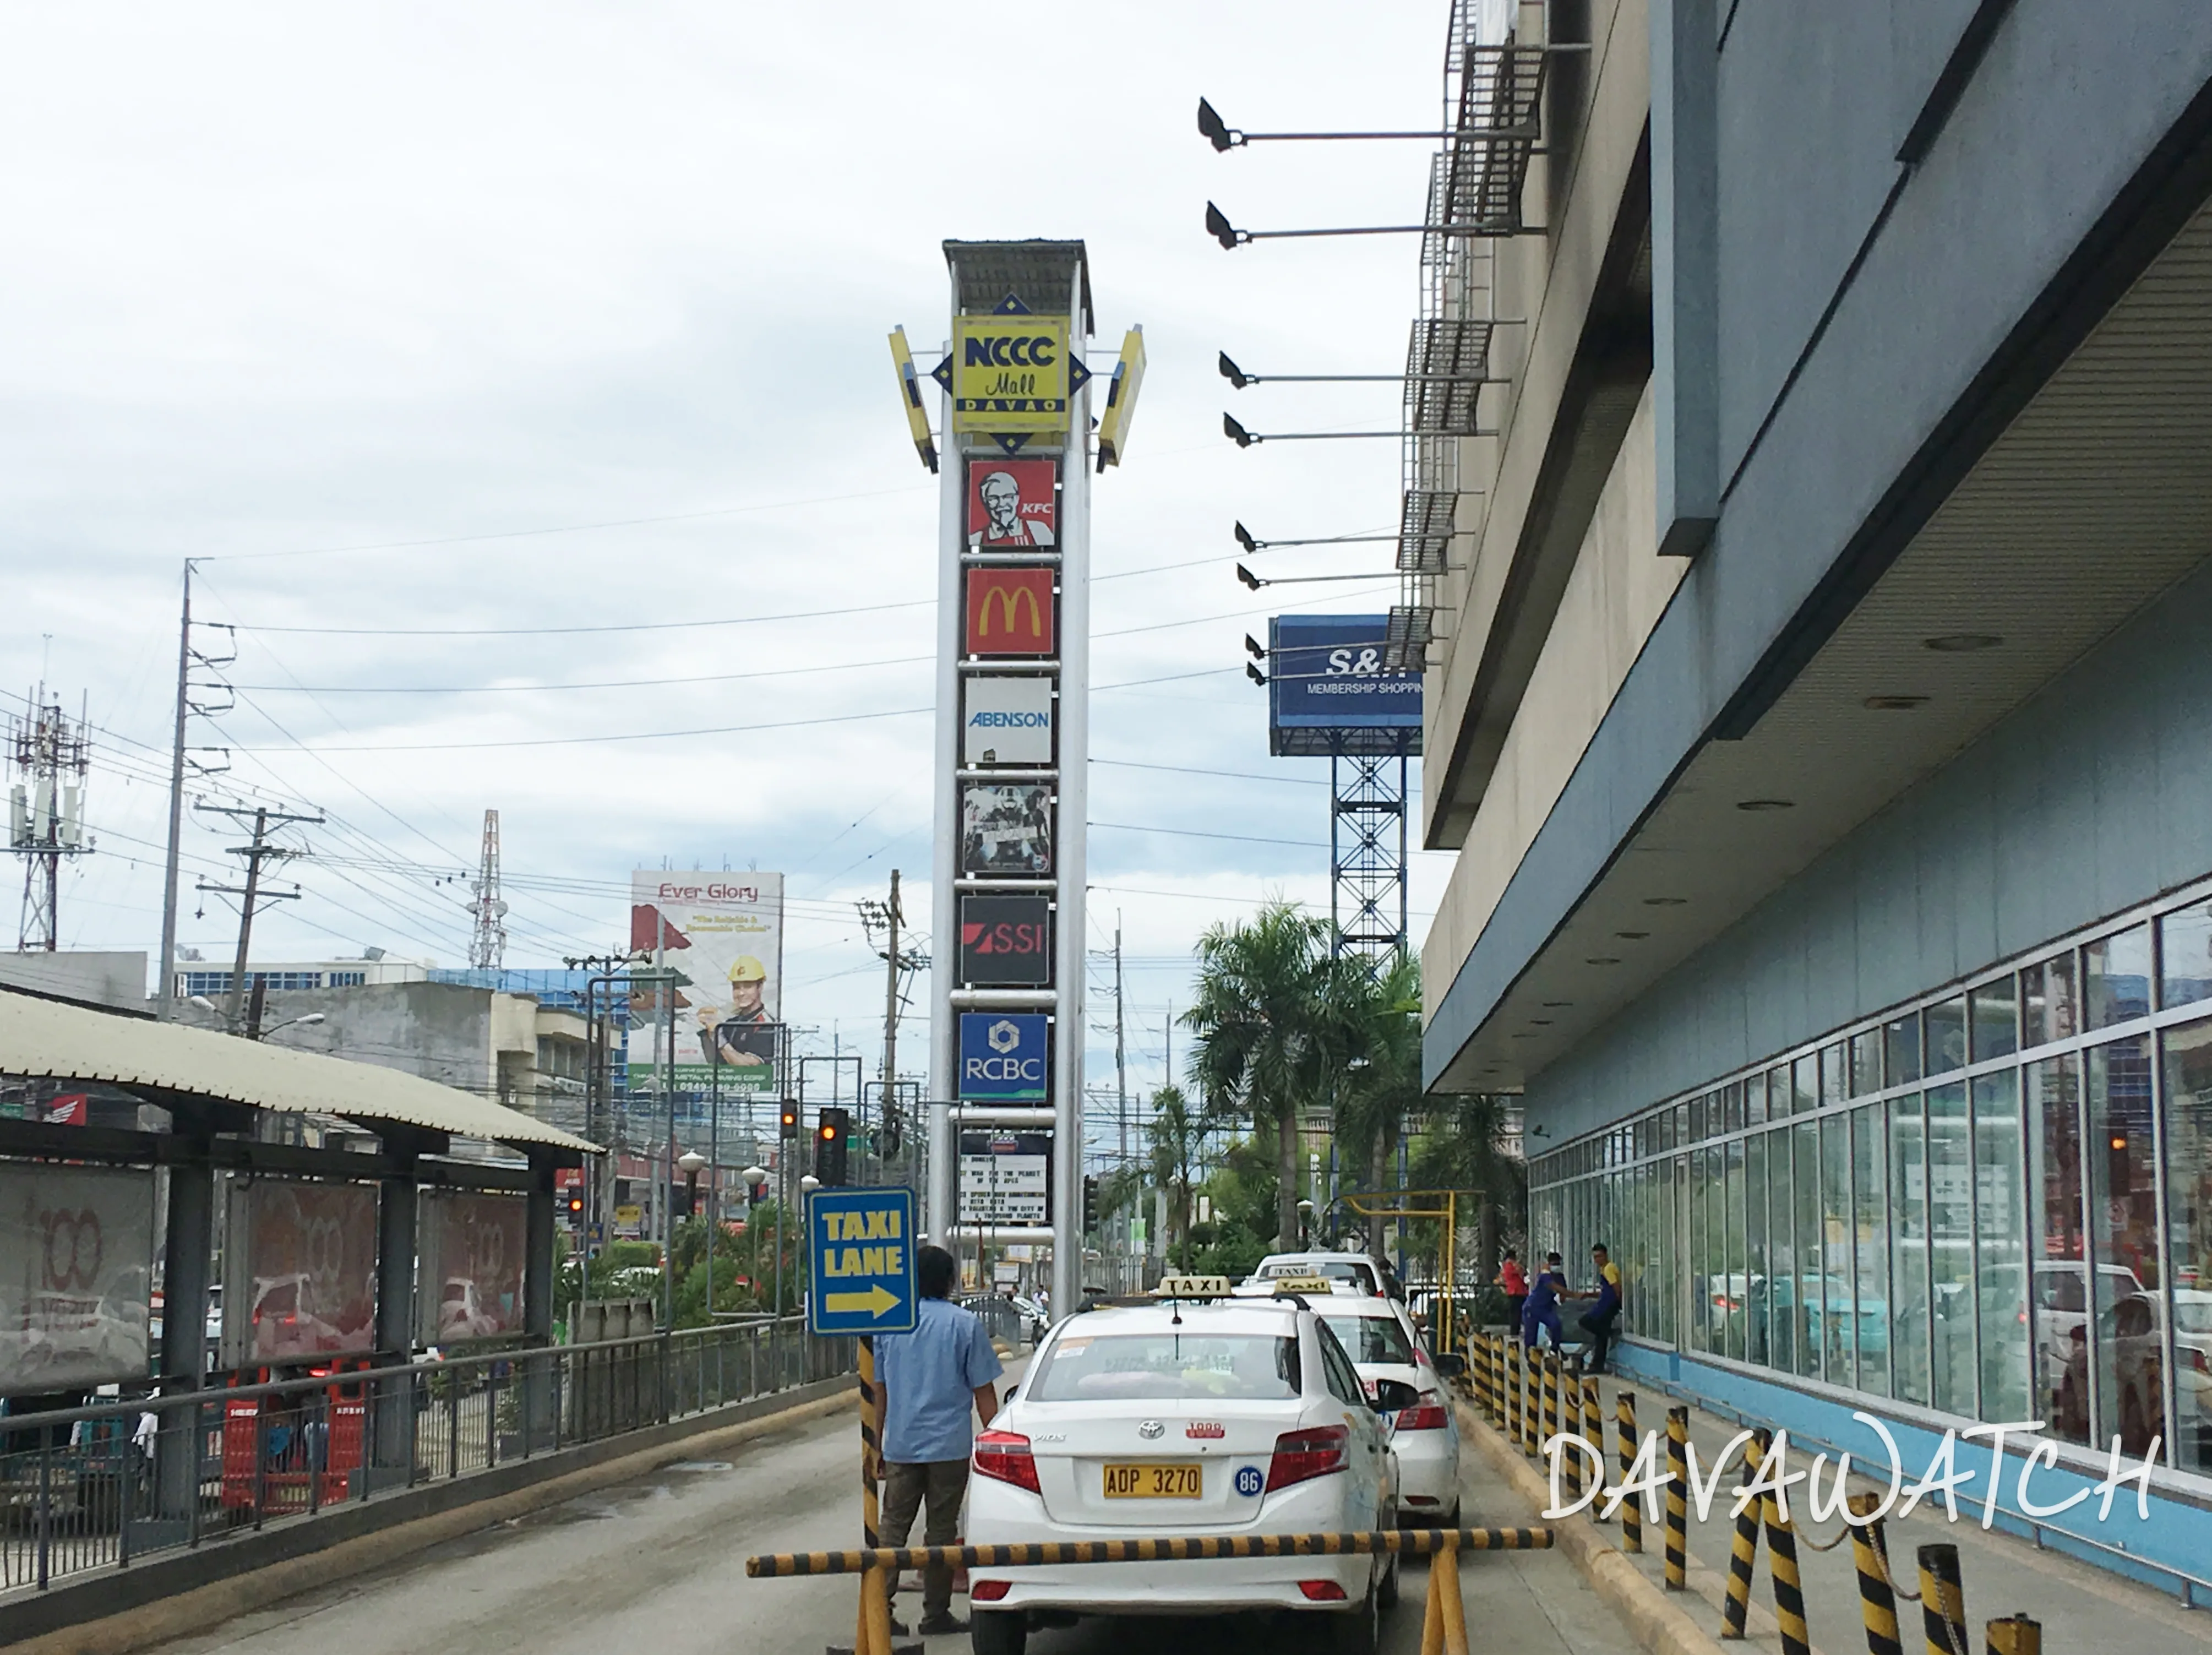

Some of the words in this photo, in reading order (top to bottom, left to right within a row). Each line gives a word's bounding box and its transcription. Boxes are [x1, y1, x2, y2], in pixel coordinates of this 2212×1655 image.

[966, 337, 1055, 367] NCCC
[986, 373, 1036, 396] Mall
[965, 400, 1056, 411] DAVAO
[1022, 503, 1052, 514] KFC
[1307, 683, 1377, 694] MEMBERSHIP
[969, 712, 1049, 727] ABENSON
[659, 883, 702, 899] Ever
[708, 883, 758, 902] Glory
[995, 923, 1043, 953] SSI
[966, 1057, 1040, 1081] RCBC
[821, 1210, 901, 1241] TAXI
[824, 1246, 903, 1277] LANE
[1167, 1280, 1221, 1291] TAXI
[1282, 1281, 1325, 1290] TAXI
[1107, 1469, 1140, 1493] ADP
[1153, 1469, 1198, 1493] 3270
[1240, 1472, 1258, 1491] 86
